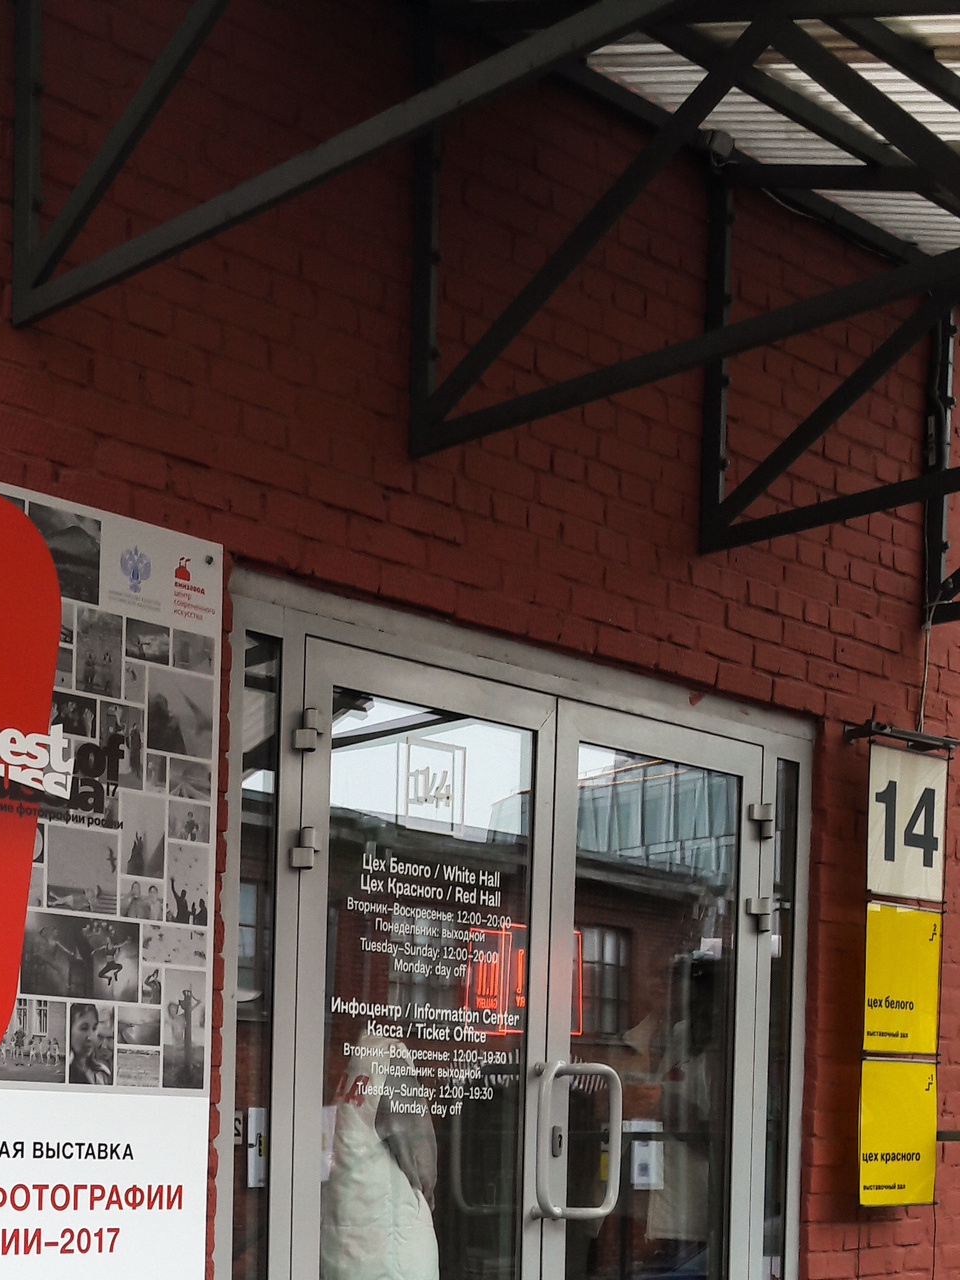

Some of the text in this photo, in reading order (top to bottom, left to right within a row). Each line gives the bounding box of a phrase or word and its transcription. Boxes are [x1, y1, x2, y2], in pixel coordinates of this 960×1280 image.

[74, 742, 125, 782] of
[16, 803, 85, 826] фотографии
[875, 780, 938, 868] 14
[362, 853, 386, 873] Цех
[390, 857, 431, 878] Белого
[443, 865, 476, 885] White
[479, 870, 501, 888] Hall
[360, 874, 384, 895] Цех
[387, 878, 444, 900] Красного
[455, 886, 477, 905] Red
[480, 891, 501, 908] Hall
[375, 917, 486, 944] Понедельник: выходной
[394, 958, 467, 979] Monday: day off
[330, 996, 402, 1021] Инфоцентр
[414, 1005, 480, 1024] Information
[482, 1008, 520, 1027] Center
[867, 995, 914, 1010] цех белого
[367, 1020, 404, 1038] Касса
[415, 1023, 450, 1042] Ticket
[453, 1026, 487, 1044] Office
[371, 1062, 481, 1080] Понедельник: выходной
[390, 1100, 463, 1118] Monday: day off
[32, 1142, 134, 1161] ВЫСТАВКА
[862, 1152, 921, 1164] цех красного
